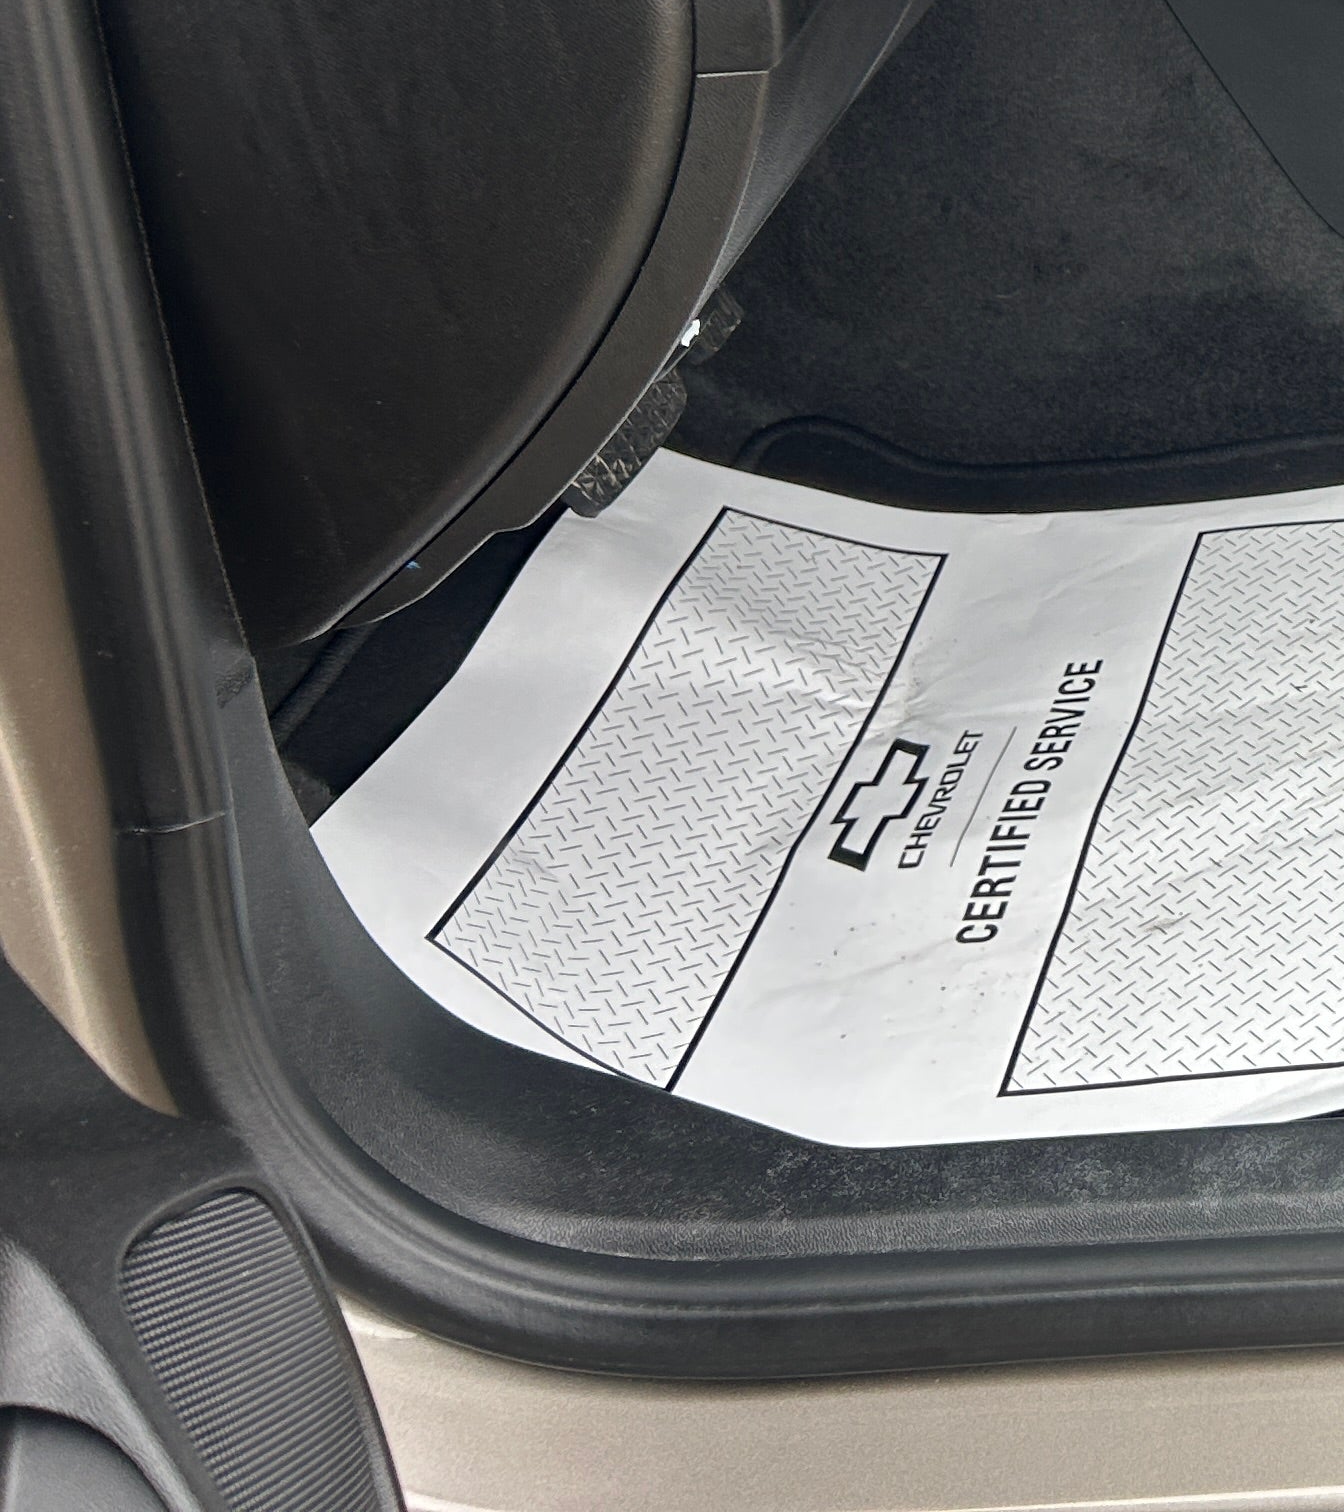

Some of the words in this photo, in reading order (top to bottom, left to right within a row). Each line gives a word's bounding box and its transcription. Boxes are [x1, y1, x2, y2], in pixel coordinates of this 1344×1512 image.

[898, 730, 983, 869] CHEVROLET
[955, 780, 1051, 944] CERTIFIED
[1023, 659, 1103, 771] SERVICE
